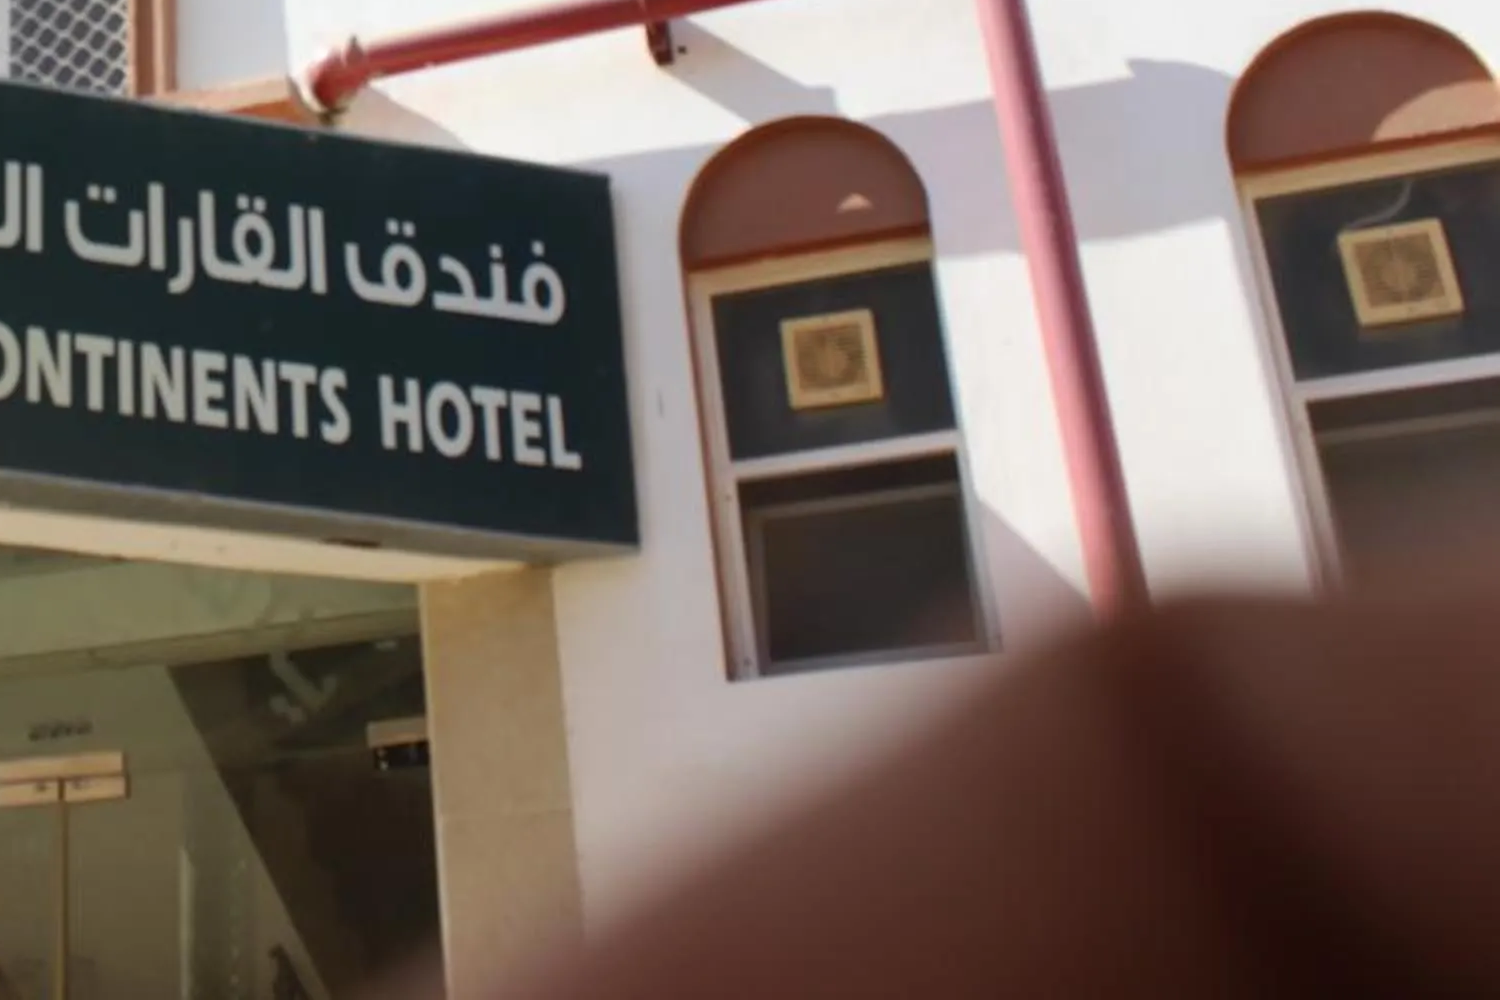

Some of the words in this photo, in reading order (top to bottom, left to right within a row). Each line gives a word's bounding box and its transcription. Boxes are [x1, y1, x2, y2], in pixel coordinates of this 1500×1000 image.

[64, 181, 328, 295] القارات
[344, 216, 566, 325] فندق
[378, 373, 583, 471] HOTEL
